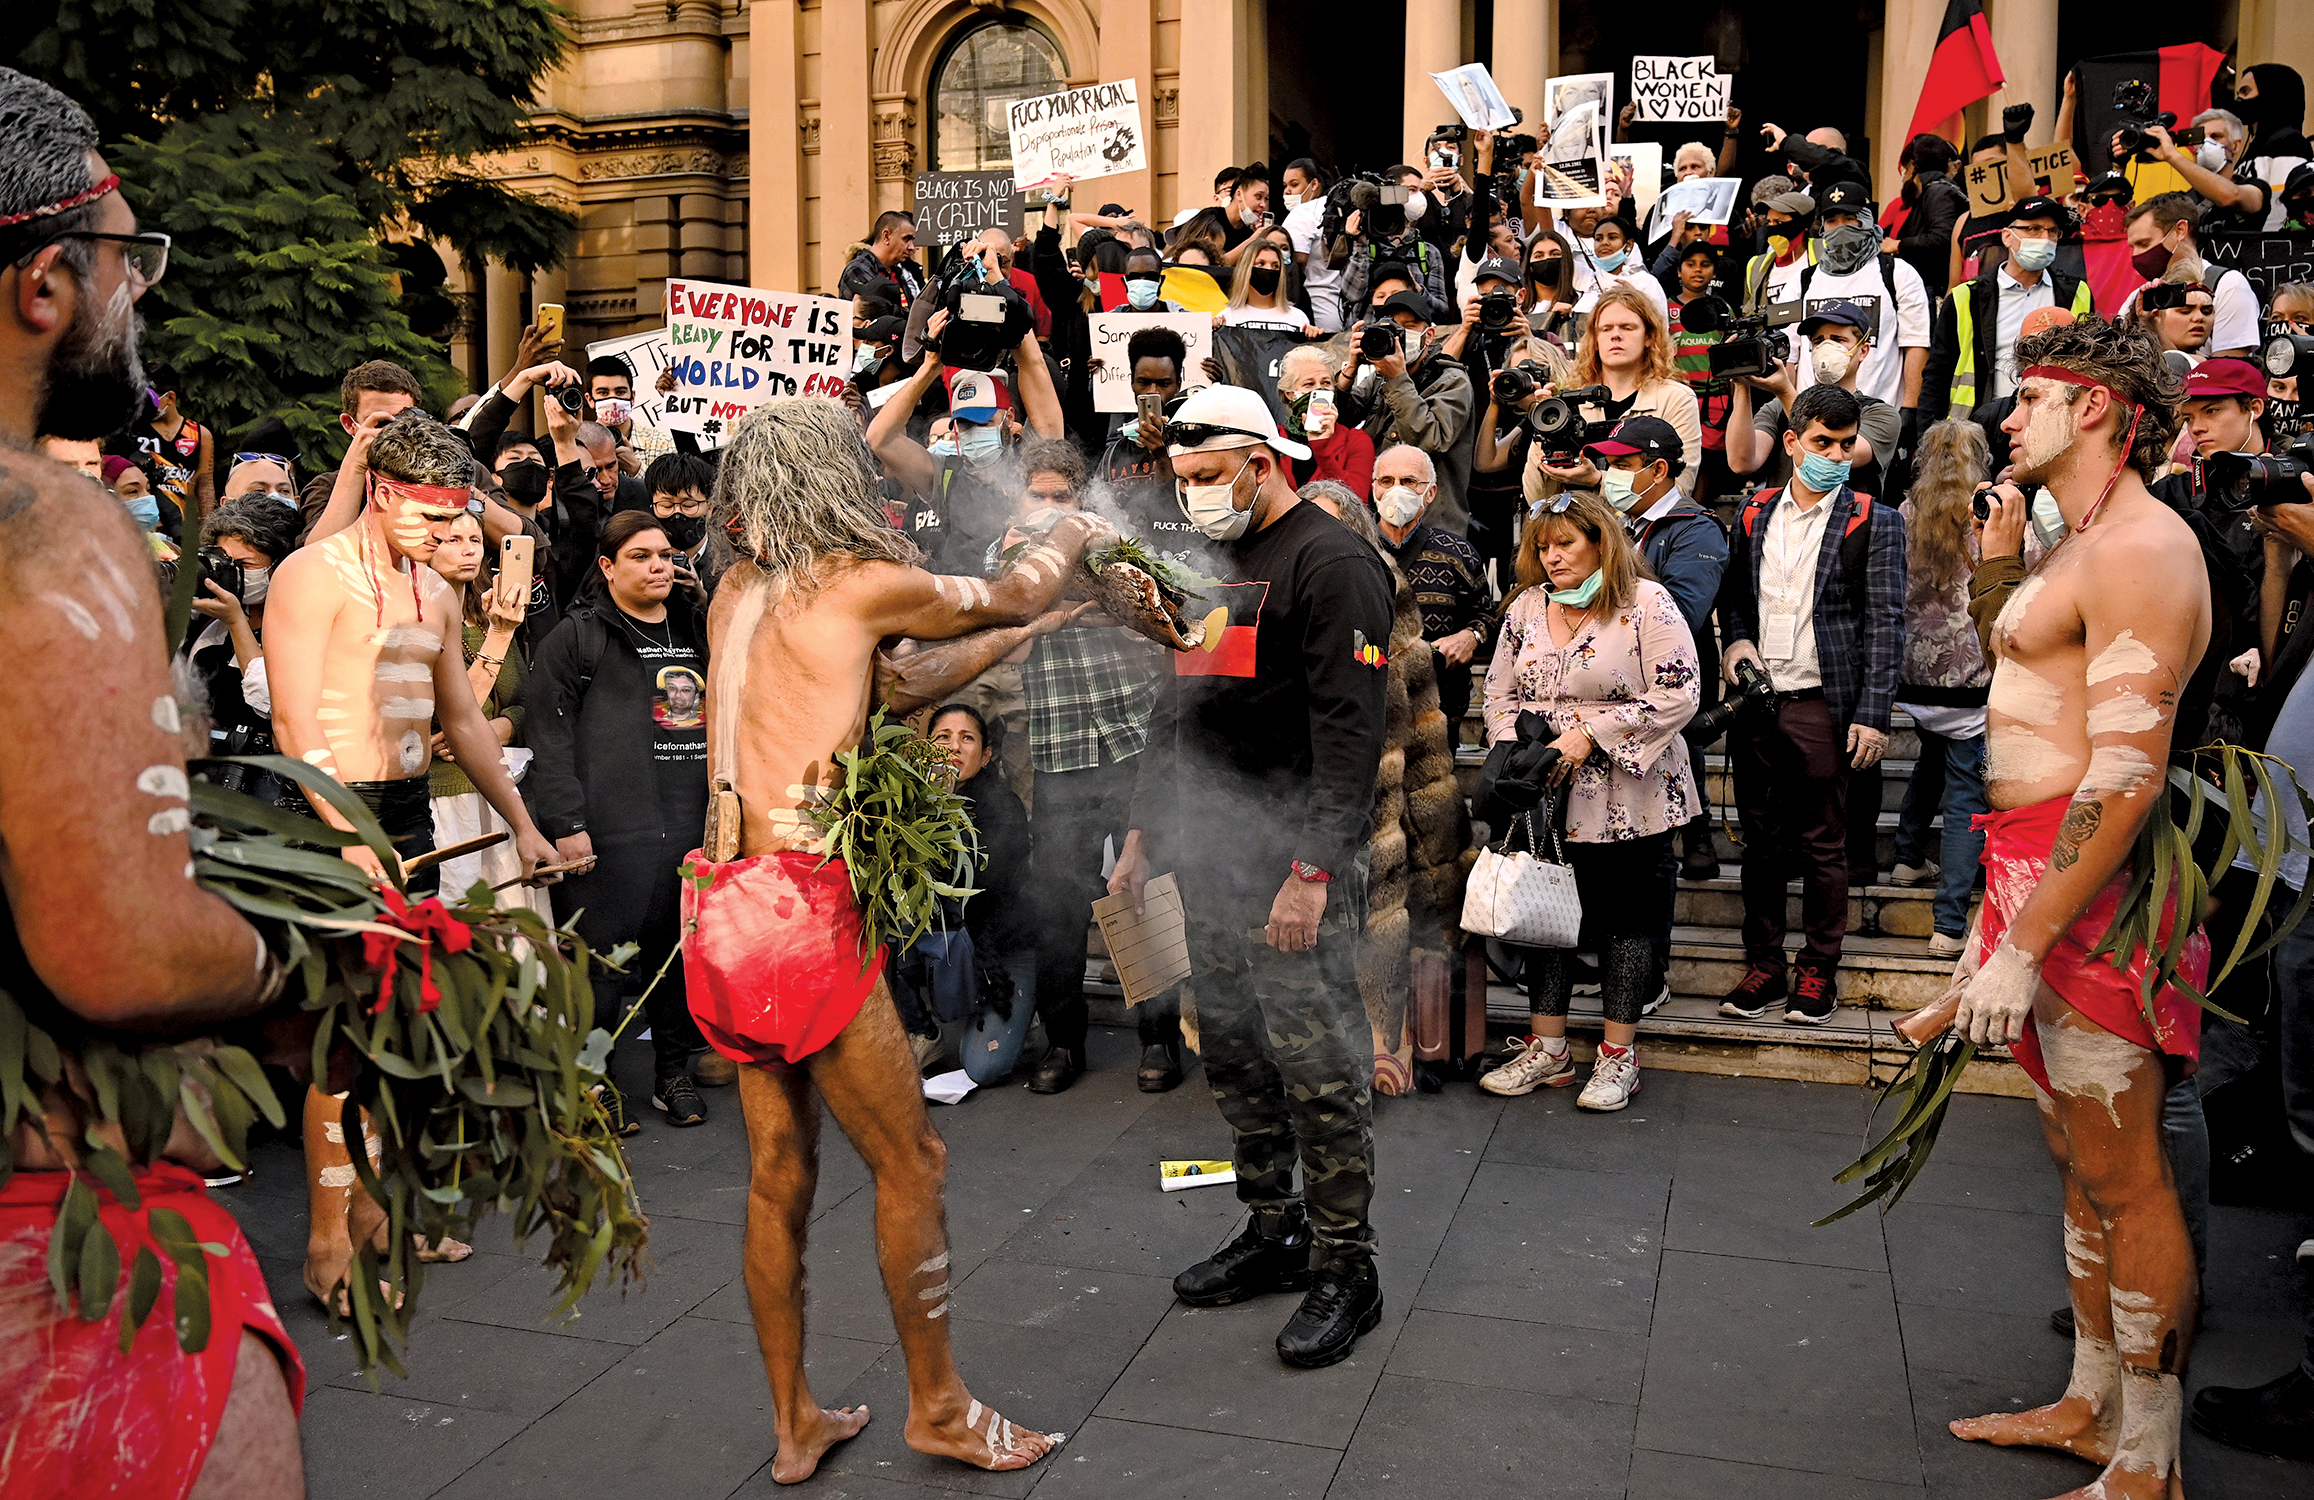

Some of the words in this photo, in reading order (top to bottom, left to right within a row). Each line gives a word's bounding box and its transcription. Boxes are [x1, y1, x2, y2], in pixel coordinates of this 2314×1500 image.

[1635, 60, 1715, 80] BLACK
[1634, 81, 1722, 98] WOMEN
[1011, 99, 1043, 131] FUCK
[1046, 91, 1081, 122] YOUR
[1081, 83, 1135, 114] RACIAL
[1637, 98, 1644, 119] I
[1675, 97, 1723, 118] YOU!
[1051, 142, 1097, 168] Population
[915, 180, 959, 199] BLACK
[963, 180, 983, 198] IS
[988, 178, 1015, 197] NOT
[1970, 149, 2071, 205] #JTICE
[915, 205, 933, 231] A
[937, 198, 1009, 230] CRIME
[671, 284, 798, 328] EVERYONE
[673, 322, 723, 353] READY
[730, 330, 774, 362] FOR
[788, 339, 842, 366] THE
[671, 355, 759, 390] WORLD
[768, 371, 797, 396] TO
[803, 373, 845, 398] END
[666, 395, 707, 414] BUT
[711, 401, 747, 420] NOT
[137, 436, 161, 454] 21
[1153, 521, 1178, 531] FUCK
[1180, 523, 1205, 534] THA
[653, 741, 707, 750] icefornathan
